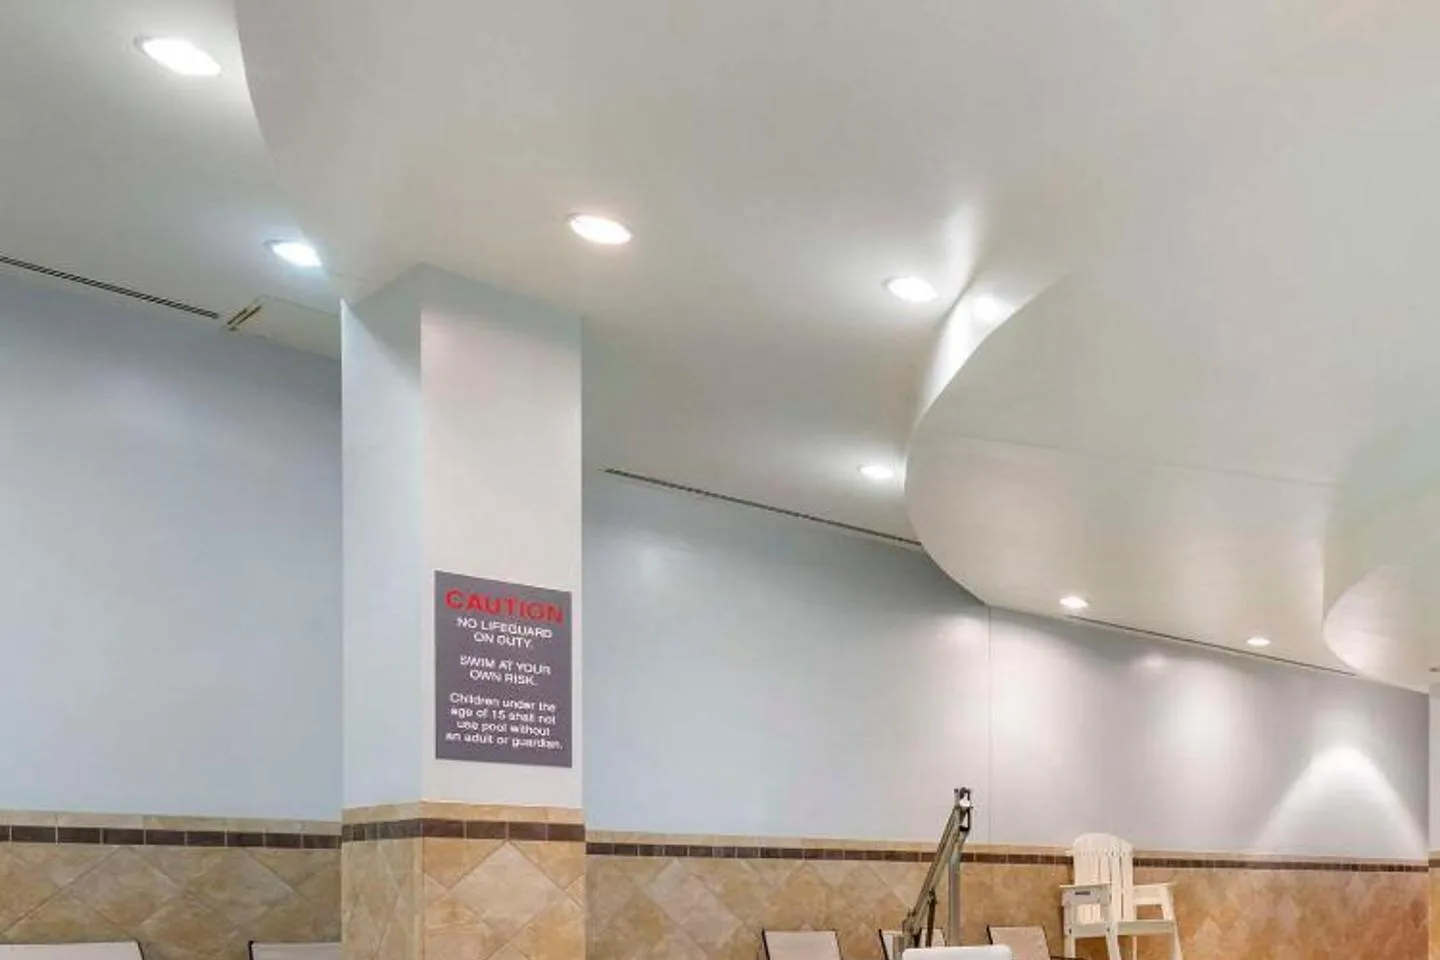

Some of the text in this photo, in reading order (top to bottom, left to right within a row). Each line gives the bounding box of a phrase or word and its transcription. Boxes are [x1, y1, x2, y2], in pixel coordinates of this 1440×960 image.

[445, 589, 563, 623] CAUTION
[457, 617, 553, 639] NO LIFEGUARD
[474, 632, 494, 643] ON
[460, 655, 551, 675] SWIM AT YOUR
[470, 669, 501, 682] OWN
[449, 692, 556, 713] Children under the
[450, 707, 473, 718] age
[476, 708, 488, 718] of
[492, 709, 506, 720] 15
[538, 714, 556, 725] not
[456, 720, 550, 736] use pool without
[464, 733, 494, 744] adult
[496, 736, 509, 745] or
